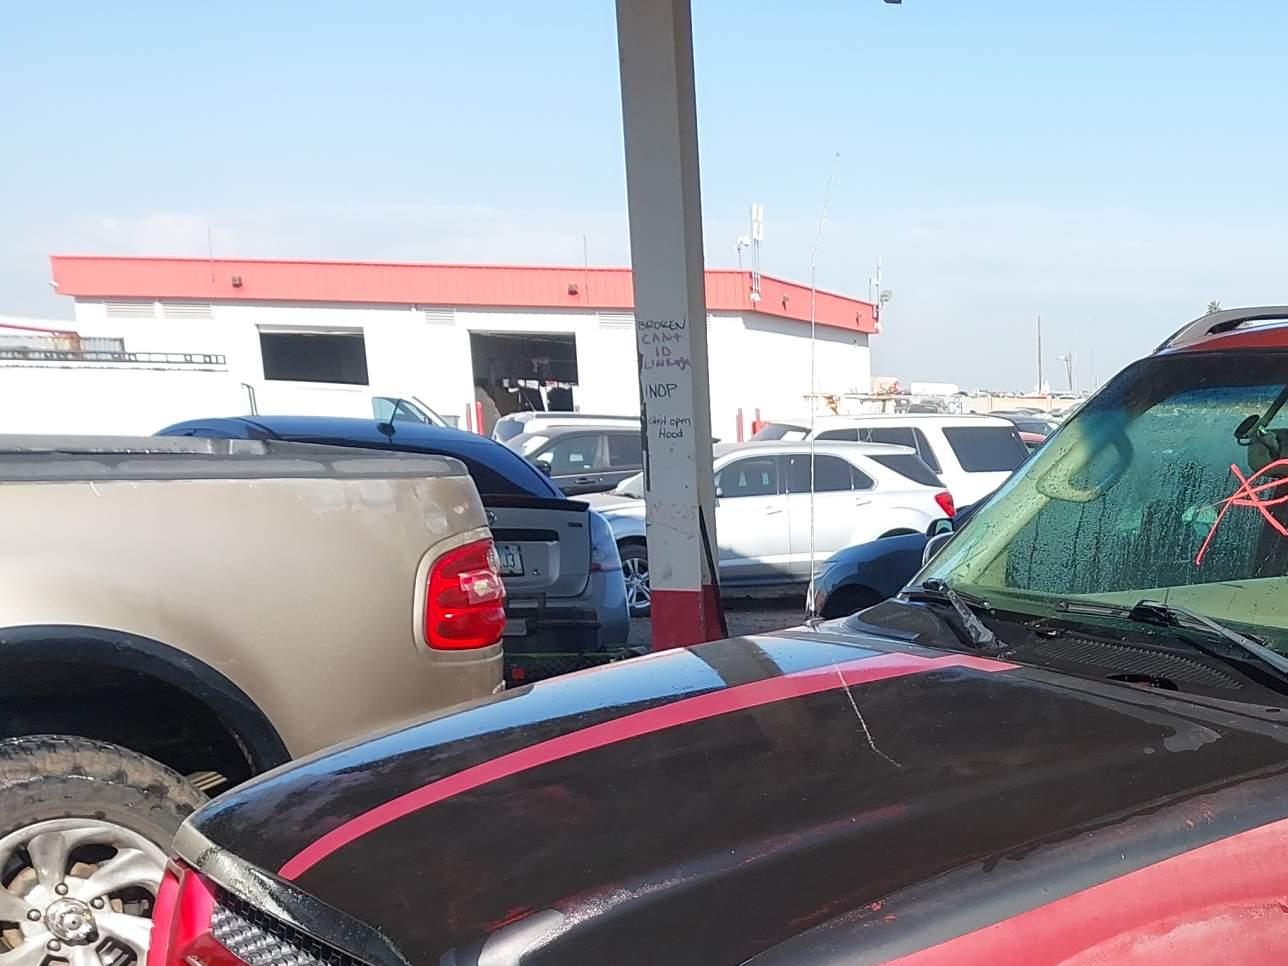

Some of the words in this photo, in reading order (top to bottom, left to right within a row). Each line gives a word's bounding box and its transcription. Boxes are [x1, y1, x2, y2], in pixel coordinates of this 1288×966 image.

[637, 318, 686, 331] BROKEN
[655, 346, 672, 357] ID
[645, 383, 678, 399] INOP
[658, 427, 683, 439] Hood
